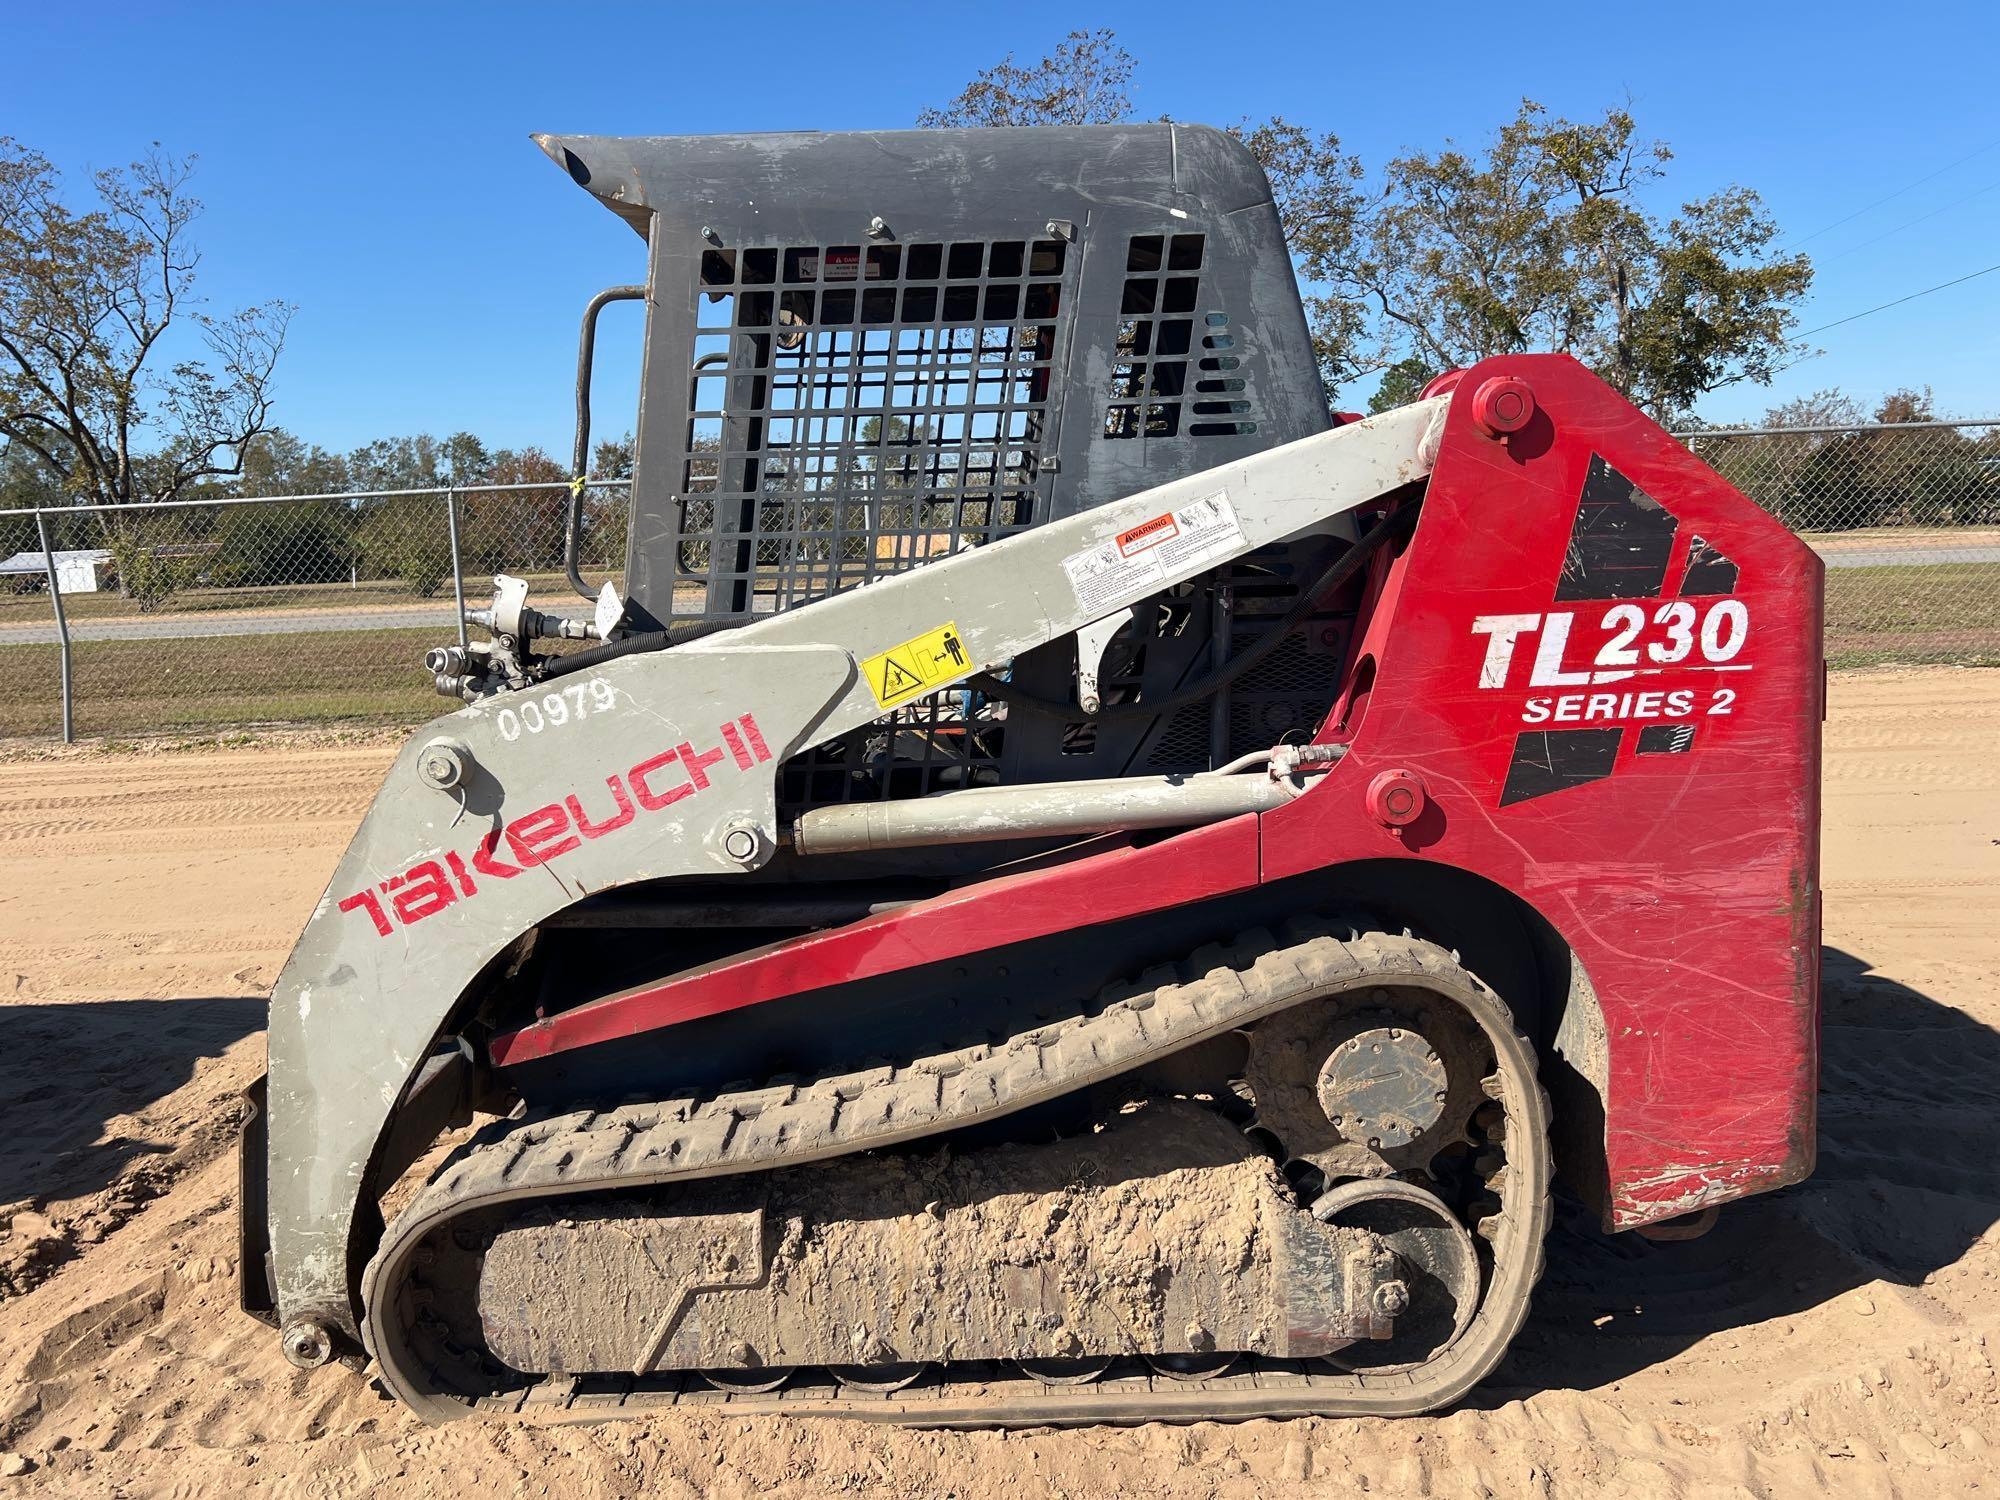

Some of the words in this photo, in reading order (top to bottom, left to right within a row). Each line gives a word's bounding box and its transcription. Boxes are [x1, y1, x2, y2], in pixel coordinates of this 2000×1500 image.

[1130, 518, 1167, 540] WARNING
[1471, 599, 1750, 689] TL230
[497, 677, 617, 742] 00979
[1521, 689, 1695, 723] SERIES
[1707, 688, 1736, 716] 2
